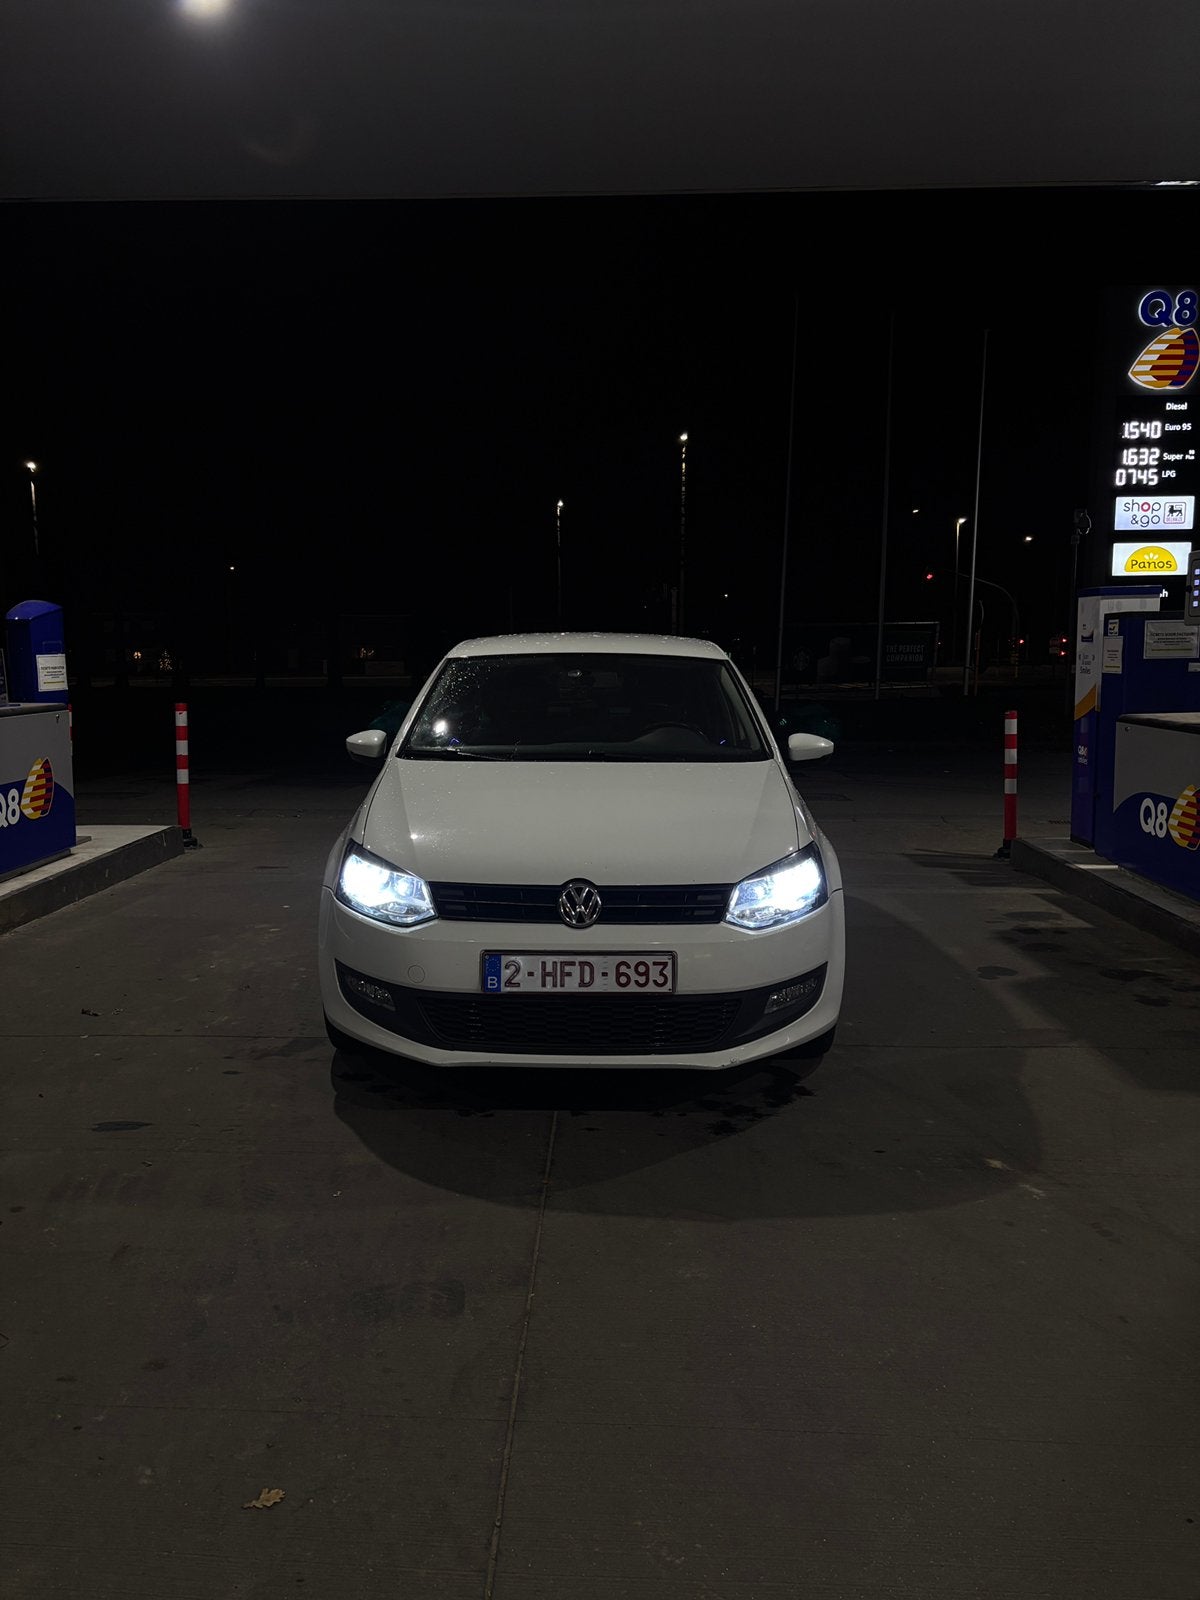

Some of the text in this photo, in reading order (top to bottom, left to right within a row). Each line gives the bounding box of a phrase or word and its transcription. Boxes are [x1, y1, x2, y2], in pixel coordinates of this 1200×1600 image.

[1138, 290, 1198, 327] Q8
[1166, 402, 1188, 411] Diesel
[1165, 423, 1181, 431] Euro
[1182, 423, 1192, 431] 95
[1163, 452, 1183, 461] Super
[1162, 470, 1176, 478] LPG
[1123, 499, 1161, 514] shop
[1131, 514, 1161, 528] &go
[1131, 560, 1172, 569] Panos
[1139, 798, 1168, 838] Q8
[487, 977, 498, 989] B
